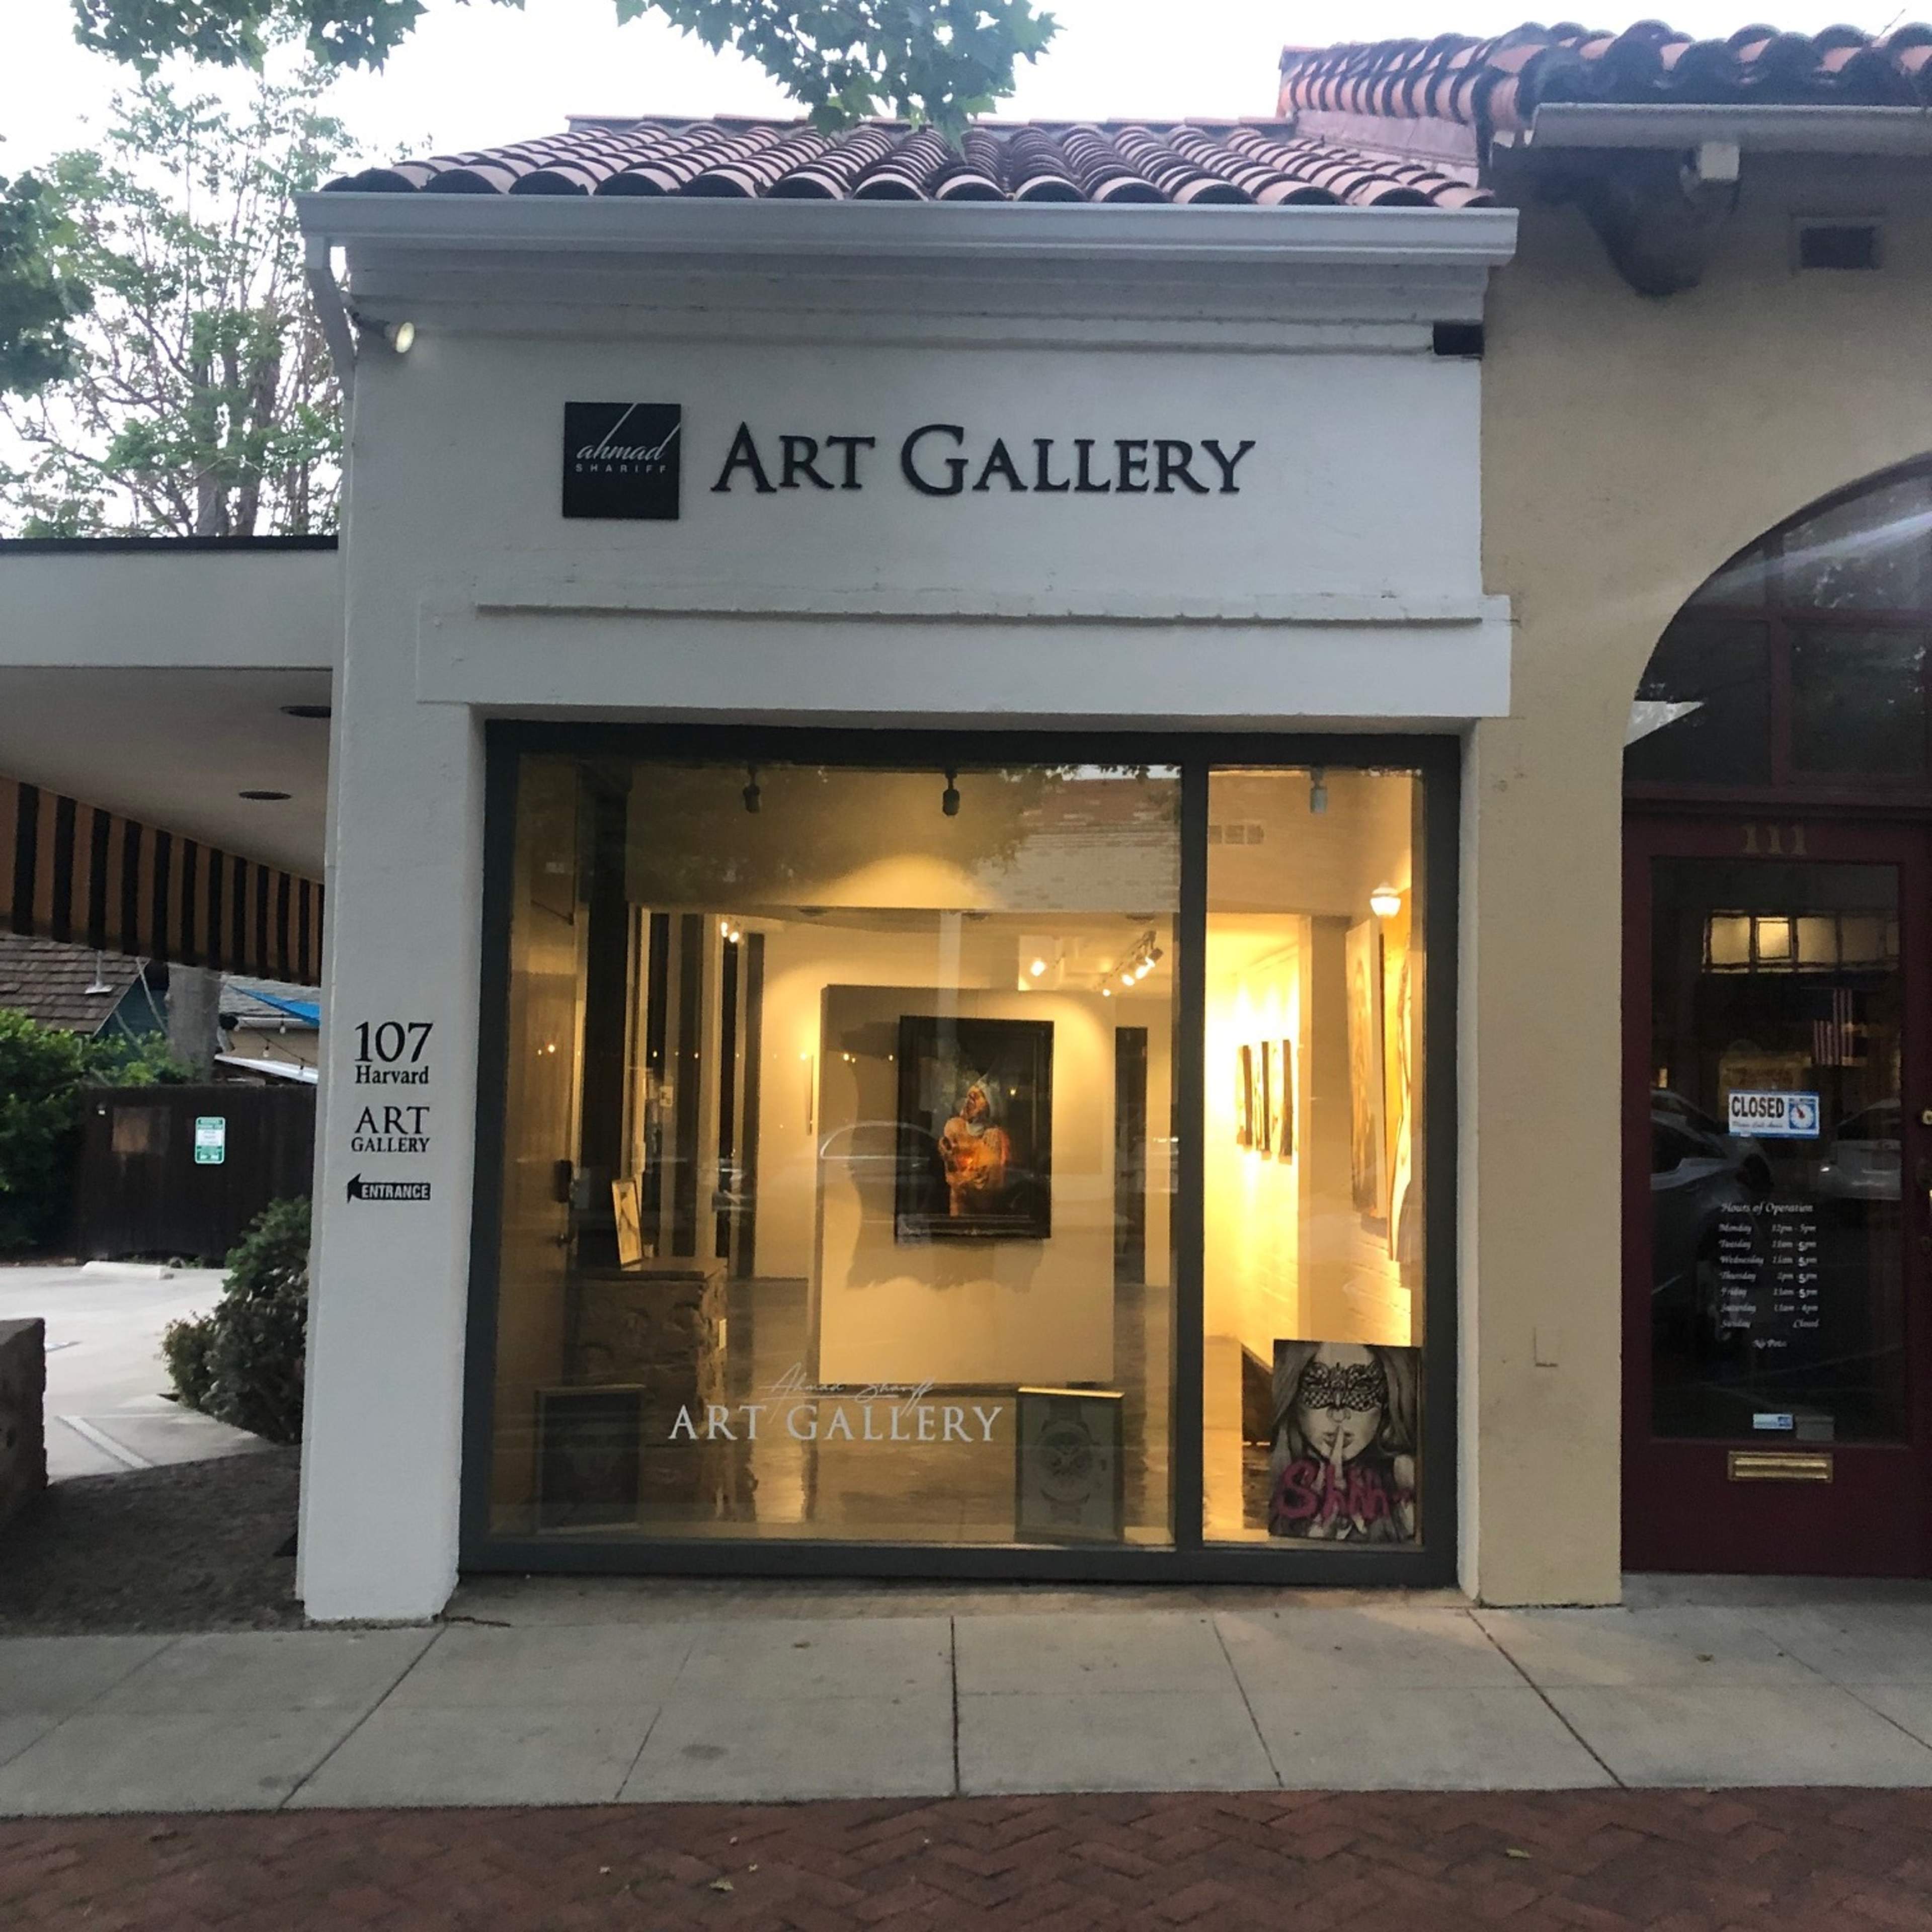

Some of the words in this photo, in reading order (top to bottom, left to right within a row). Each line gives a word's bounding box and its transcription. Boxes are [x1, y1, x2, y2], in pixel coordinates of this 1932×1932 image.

[575, 463, 666, 473] SHARIFF
[1740, 824, 1808, 855] 111
[354, 1021, 434, 1063] 107
[355, 1065, 429, 1085] Harvard
[1731, 1096, 1785, 1118] CLOSED
[354, 1106, 430, 1135] ART
[351, 1137, 430, 1153] GALLERY
[361, 1183, 430, 1199] ENTRANCE
[1721, 1202, 1751, 1213] Hours
[1752, 1201, 1762, 1216] of
[1765, 1202, 1813, 1216] Operation
[668, 1404, 768, 1441] ART
[786, 1404, 1003, 1443] GALLERY
